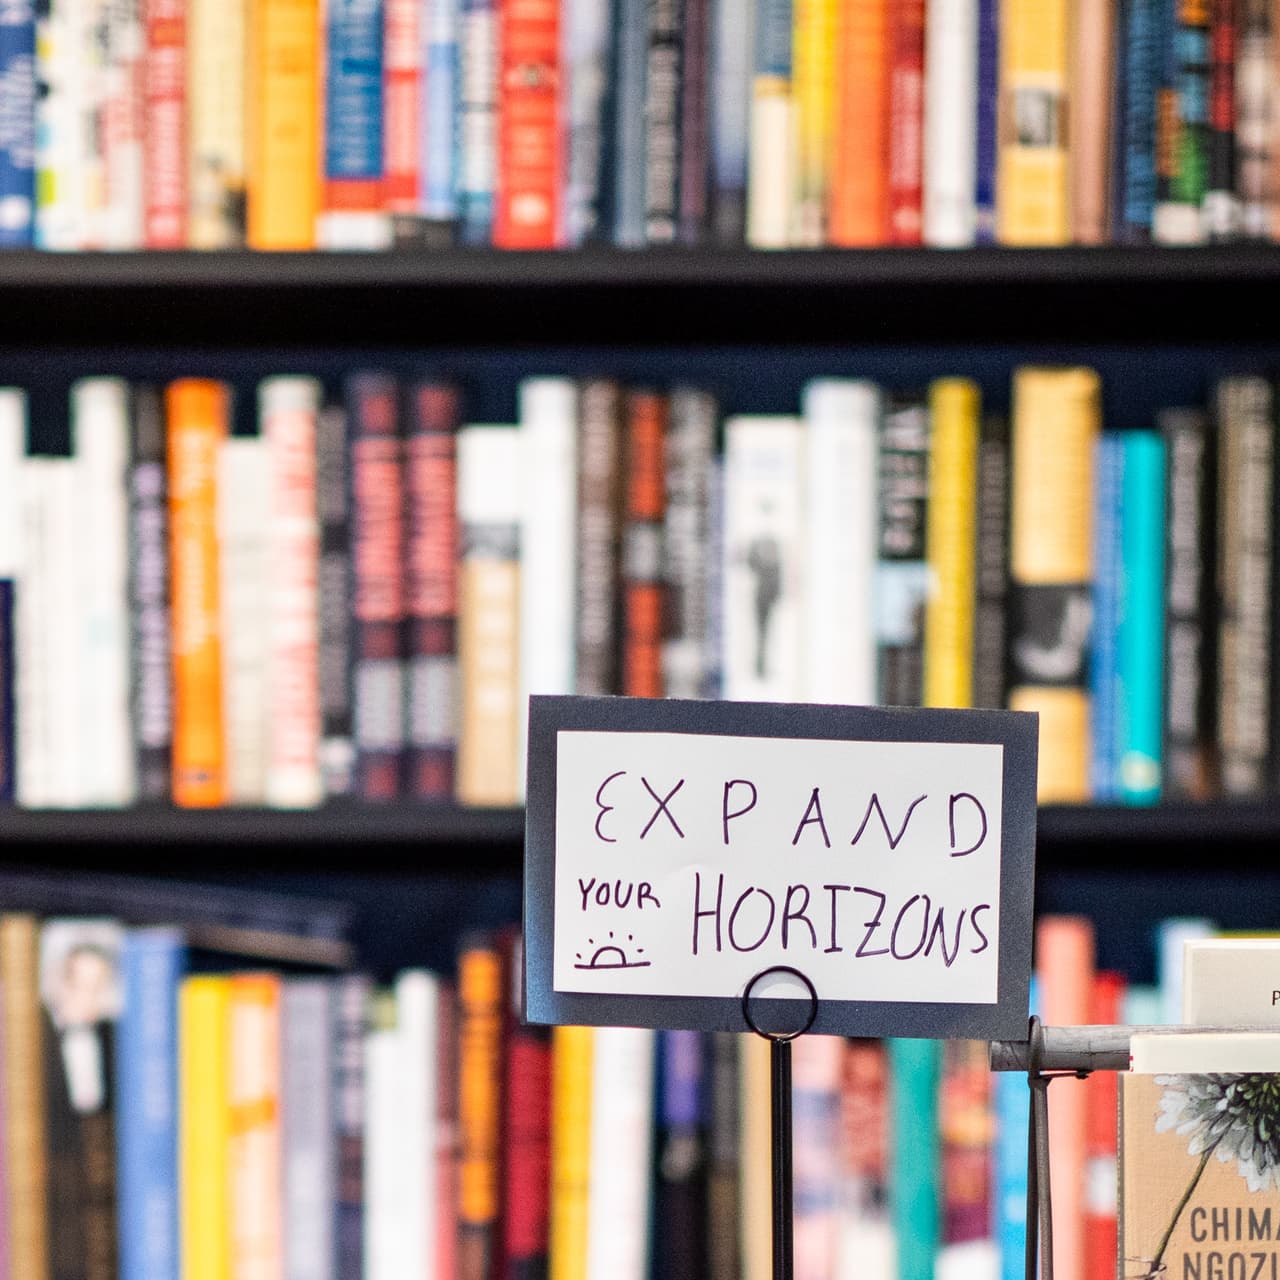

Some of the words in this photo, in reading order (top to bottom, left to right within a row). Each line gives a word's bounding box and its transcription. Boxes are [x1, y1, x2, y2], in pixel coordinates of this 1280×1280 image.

[595, 772, 987, 857] EXPAND
[578, 877, 661, 911] YOUR
[693, 872, 990, 968] HORIZONS
